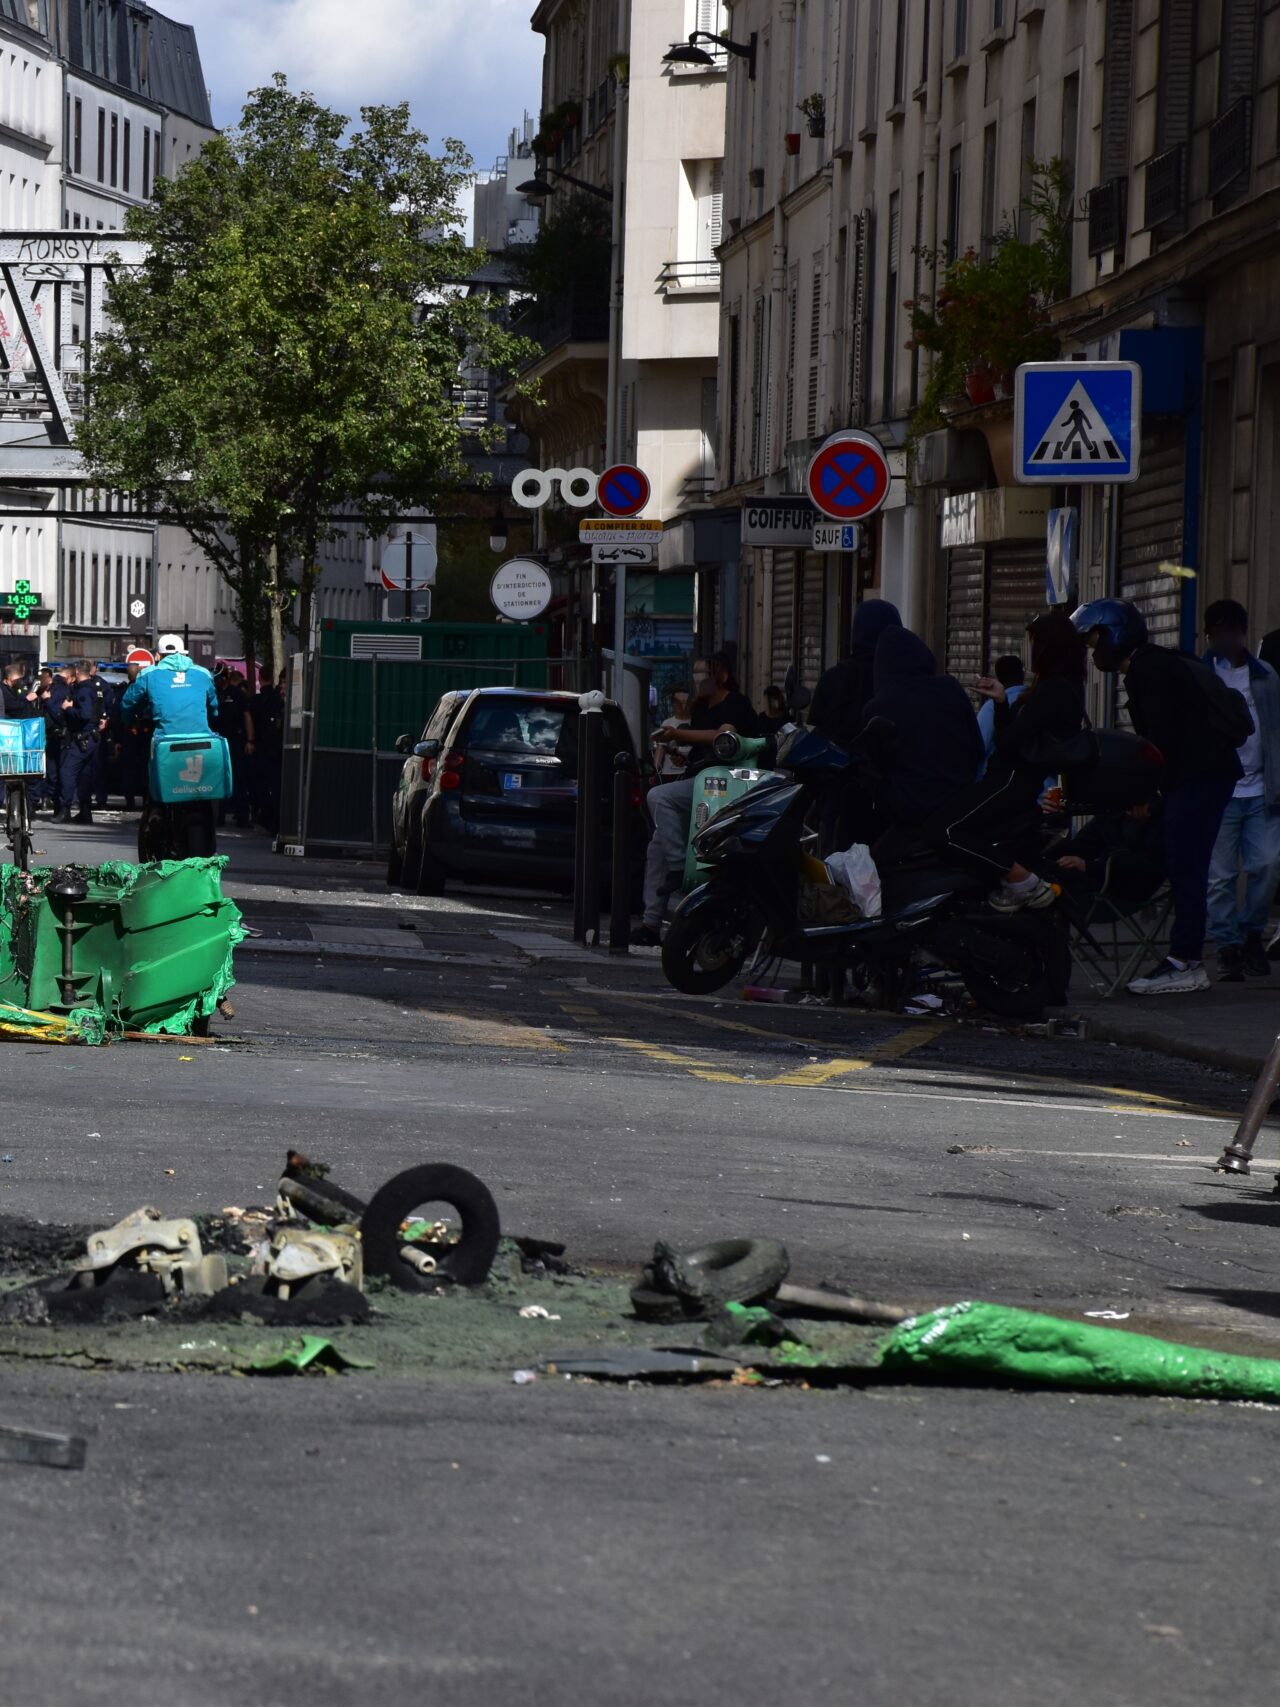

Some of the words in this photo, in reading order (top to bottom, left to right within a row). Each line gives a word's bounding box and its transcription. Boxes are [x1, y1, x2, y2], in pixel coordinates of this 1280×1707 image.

[594, 522, 638, 531] COMPTER
[640, 522, 653, 531] DU
[815, 530, 841, 545] SAUF
[496, 581, 547, 590] D'INTERDICTION
[503, 599, 542, 608] STATIONNER
